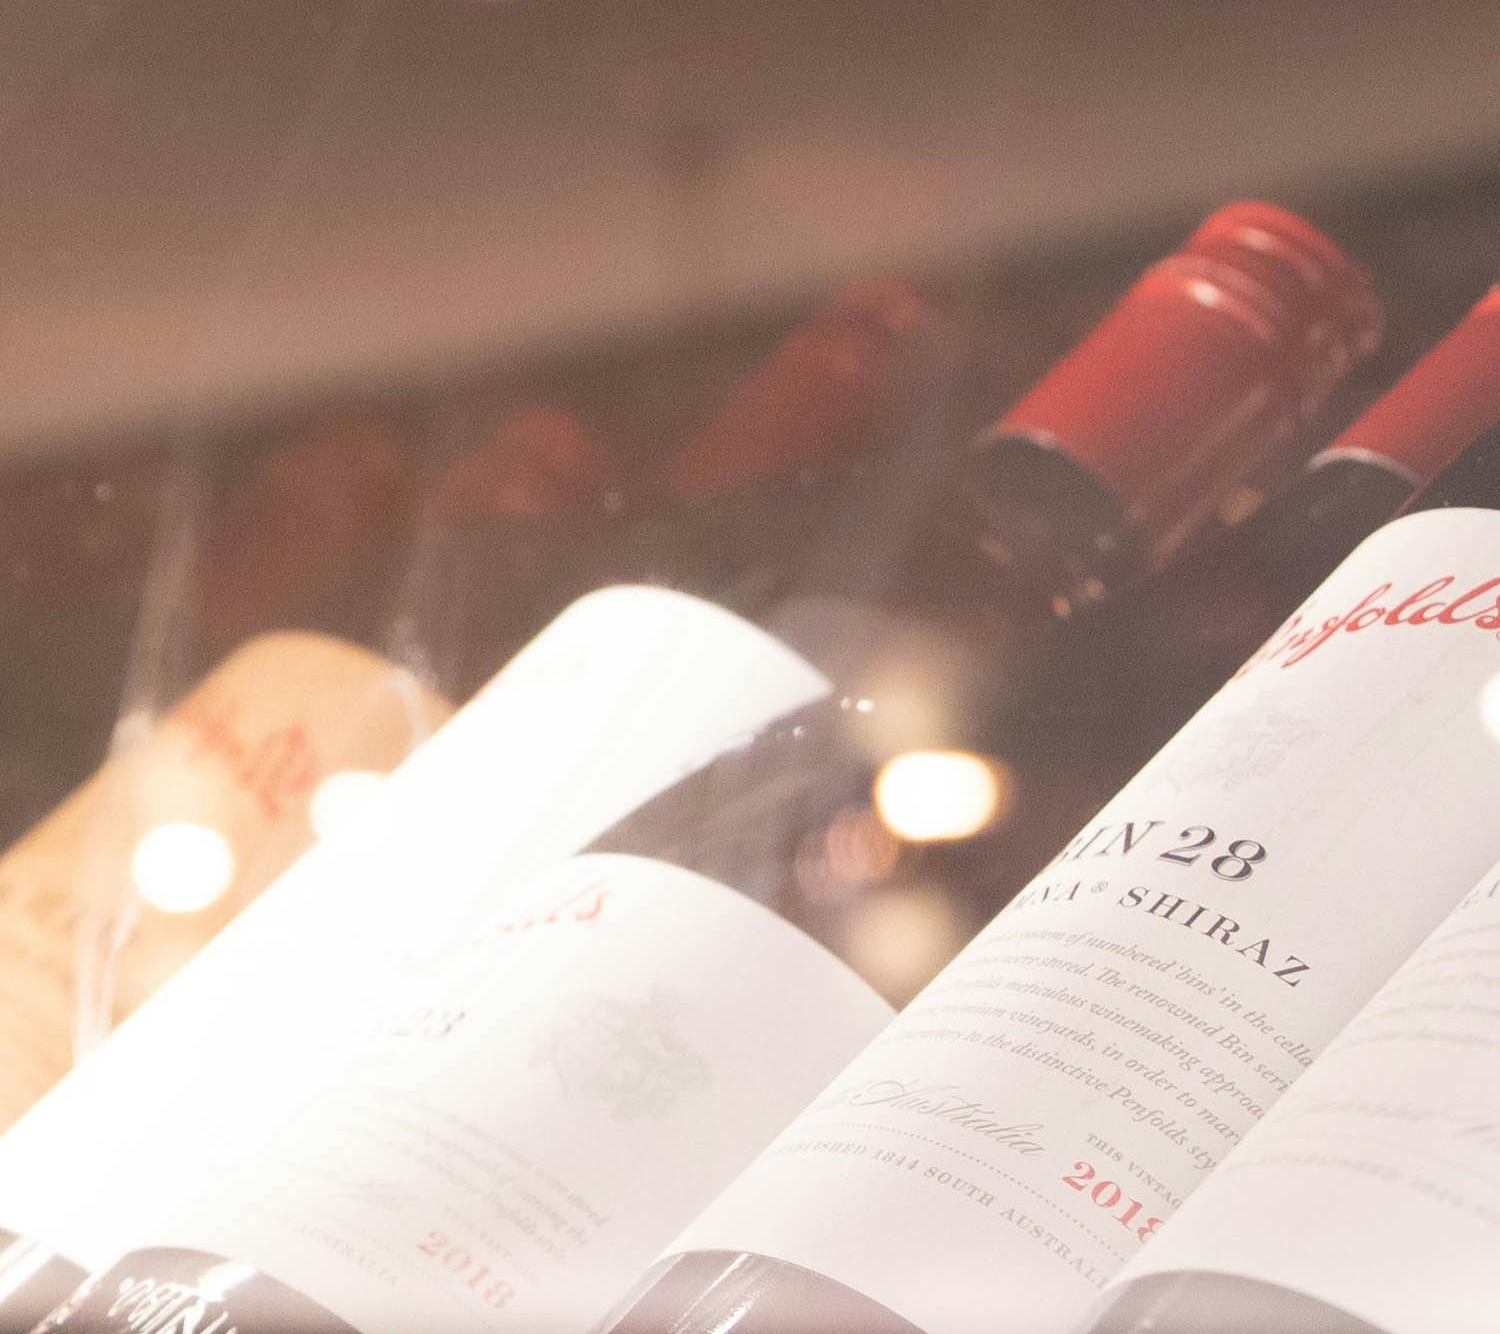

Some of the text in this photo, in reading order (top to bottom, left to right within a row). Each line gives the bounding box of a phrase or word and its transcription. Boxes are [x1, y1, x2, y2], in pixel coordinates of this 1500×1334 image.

[1158, 824, 1268, 882] 28
[1117, 885, 1312, 988] SHIRAZ
[1087, 933, 1178, 974] numbered
[1220, 992, 1243, 1012] in
[1243, 1010, 1275, 1036] the
[1096, 966, 1128, 989] The
[1127, 983, 1224, 1038] renowned
[1219, 1033, 1255, 1065] Bin
[1089, 1001, 1201, 1072] winemaking
[983, 1031, 1013, 1050] the
[1010, 1039, 1110, 1093] distinctive
[1108, 1084, 1190, 1148] Penfolds
[1101, 1041, 1123, 1061] in
[1124, 1058, 1178, 1093] order
[1175, 1090, 1197, 1109] to
[1087, 1132, 1125, 1163] THIS
[922, 1165, 998, 1210] SOUTH
[415, 1228, 516, 1309] 2018
